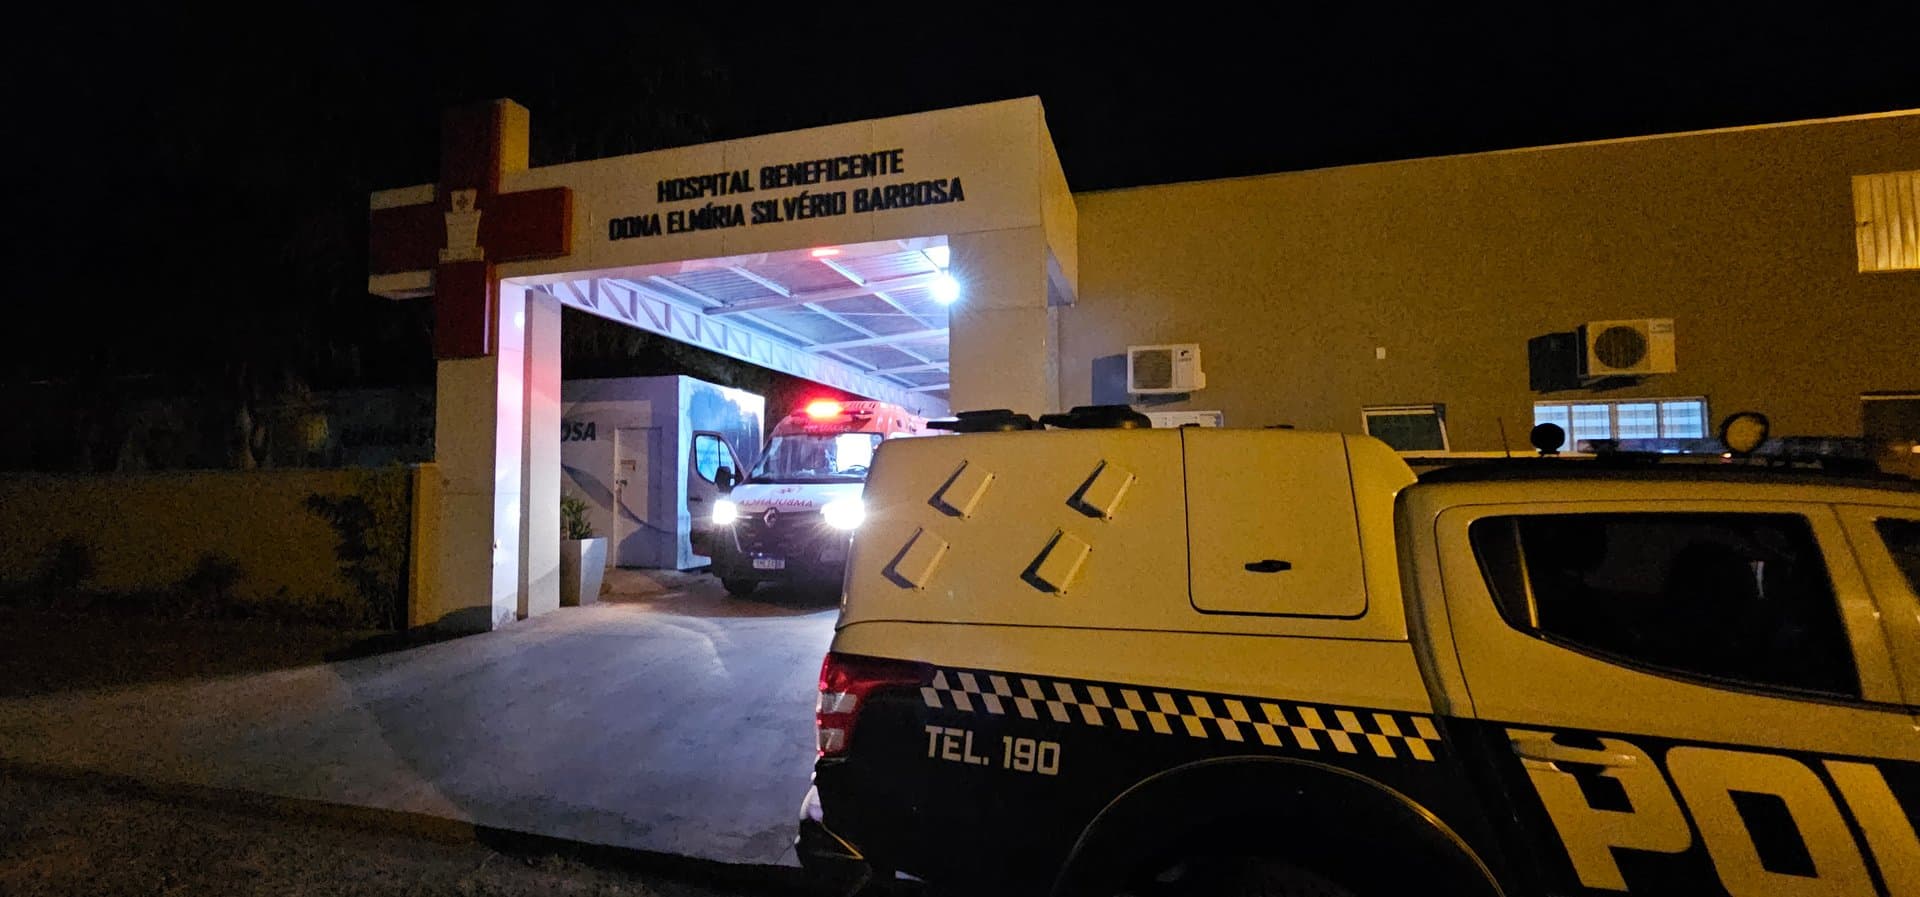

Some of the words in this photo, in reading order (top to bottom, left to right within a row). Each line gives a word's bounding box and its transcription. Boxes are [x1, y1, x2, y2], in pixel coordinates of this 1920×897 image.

[657, 169, 754, 203] HOSPITAL
[760, 149, 904, 190] BENEFICENTE
[609, 213, 662, 241] DONA
[667, 202, 745, 234] ELMÍRIA
[751, 191, 846, 225] SILVÉRIO
[853, 177, 965, 213] BARBOSA
[925, 724, 990, 766] TEL.
[1003, 735, 1061, 776] 190
